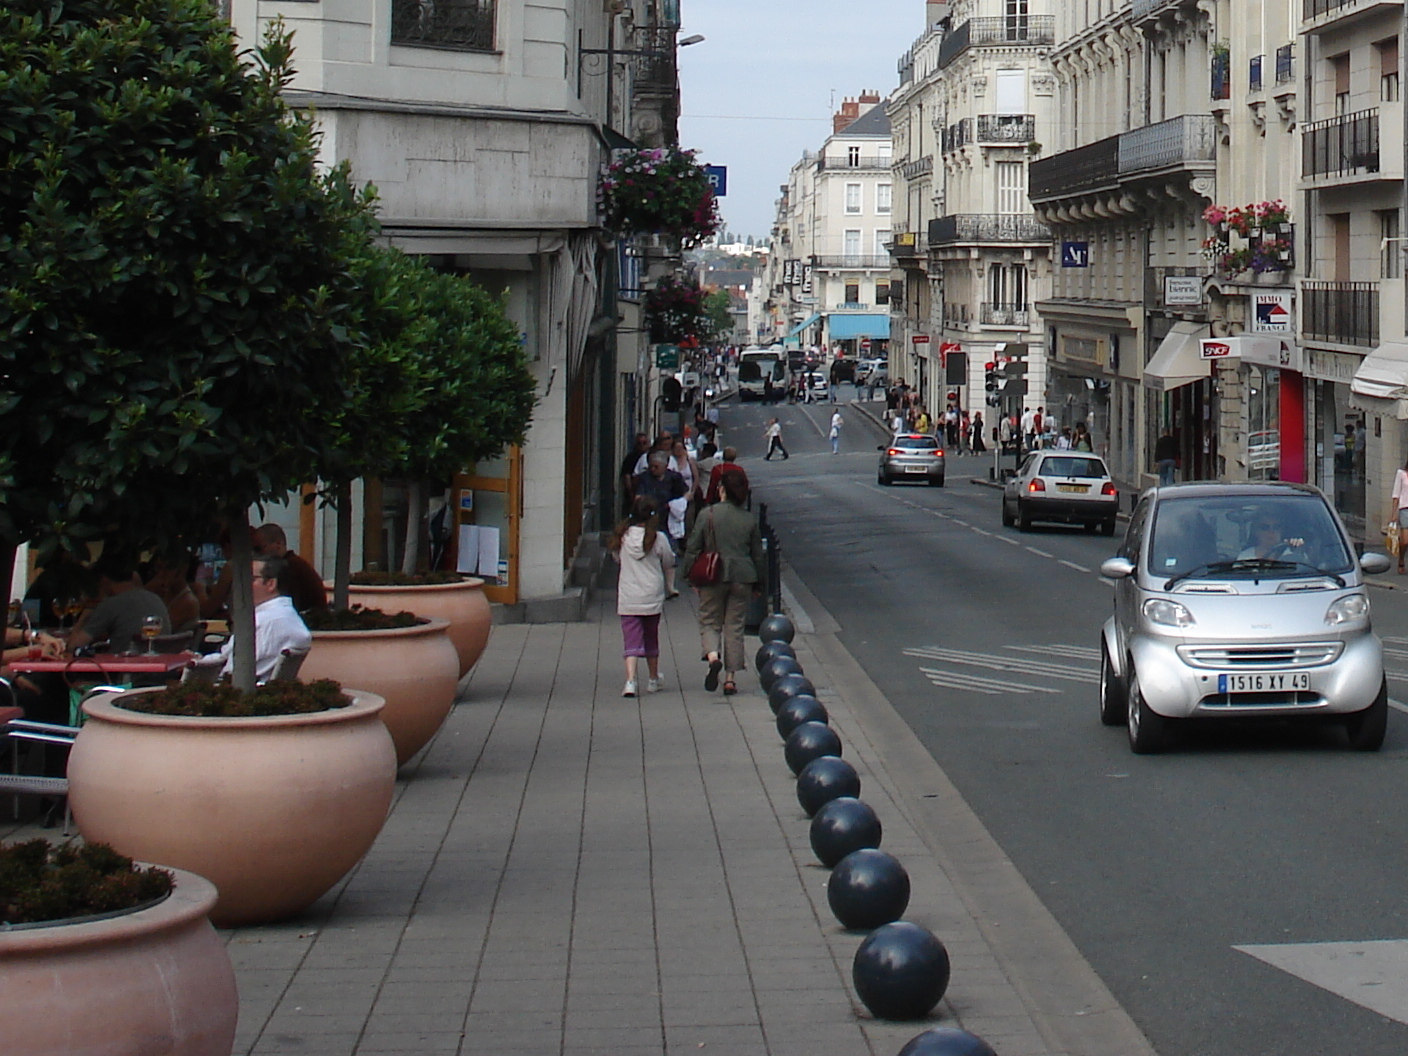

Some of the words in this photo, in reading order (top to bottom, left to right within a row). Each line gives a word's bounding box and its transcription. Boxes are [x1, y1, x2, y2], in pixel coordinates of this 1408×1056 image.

[1256, 295, 1282, 304] IMMO
[1204, 347, 1229, 357] SNCF
[1230, 675, 1263, 691] 1516
[1269, 675, 1285, 690] XY
[1292, 674, 1308, 689] 49
